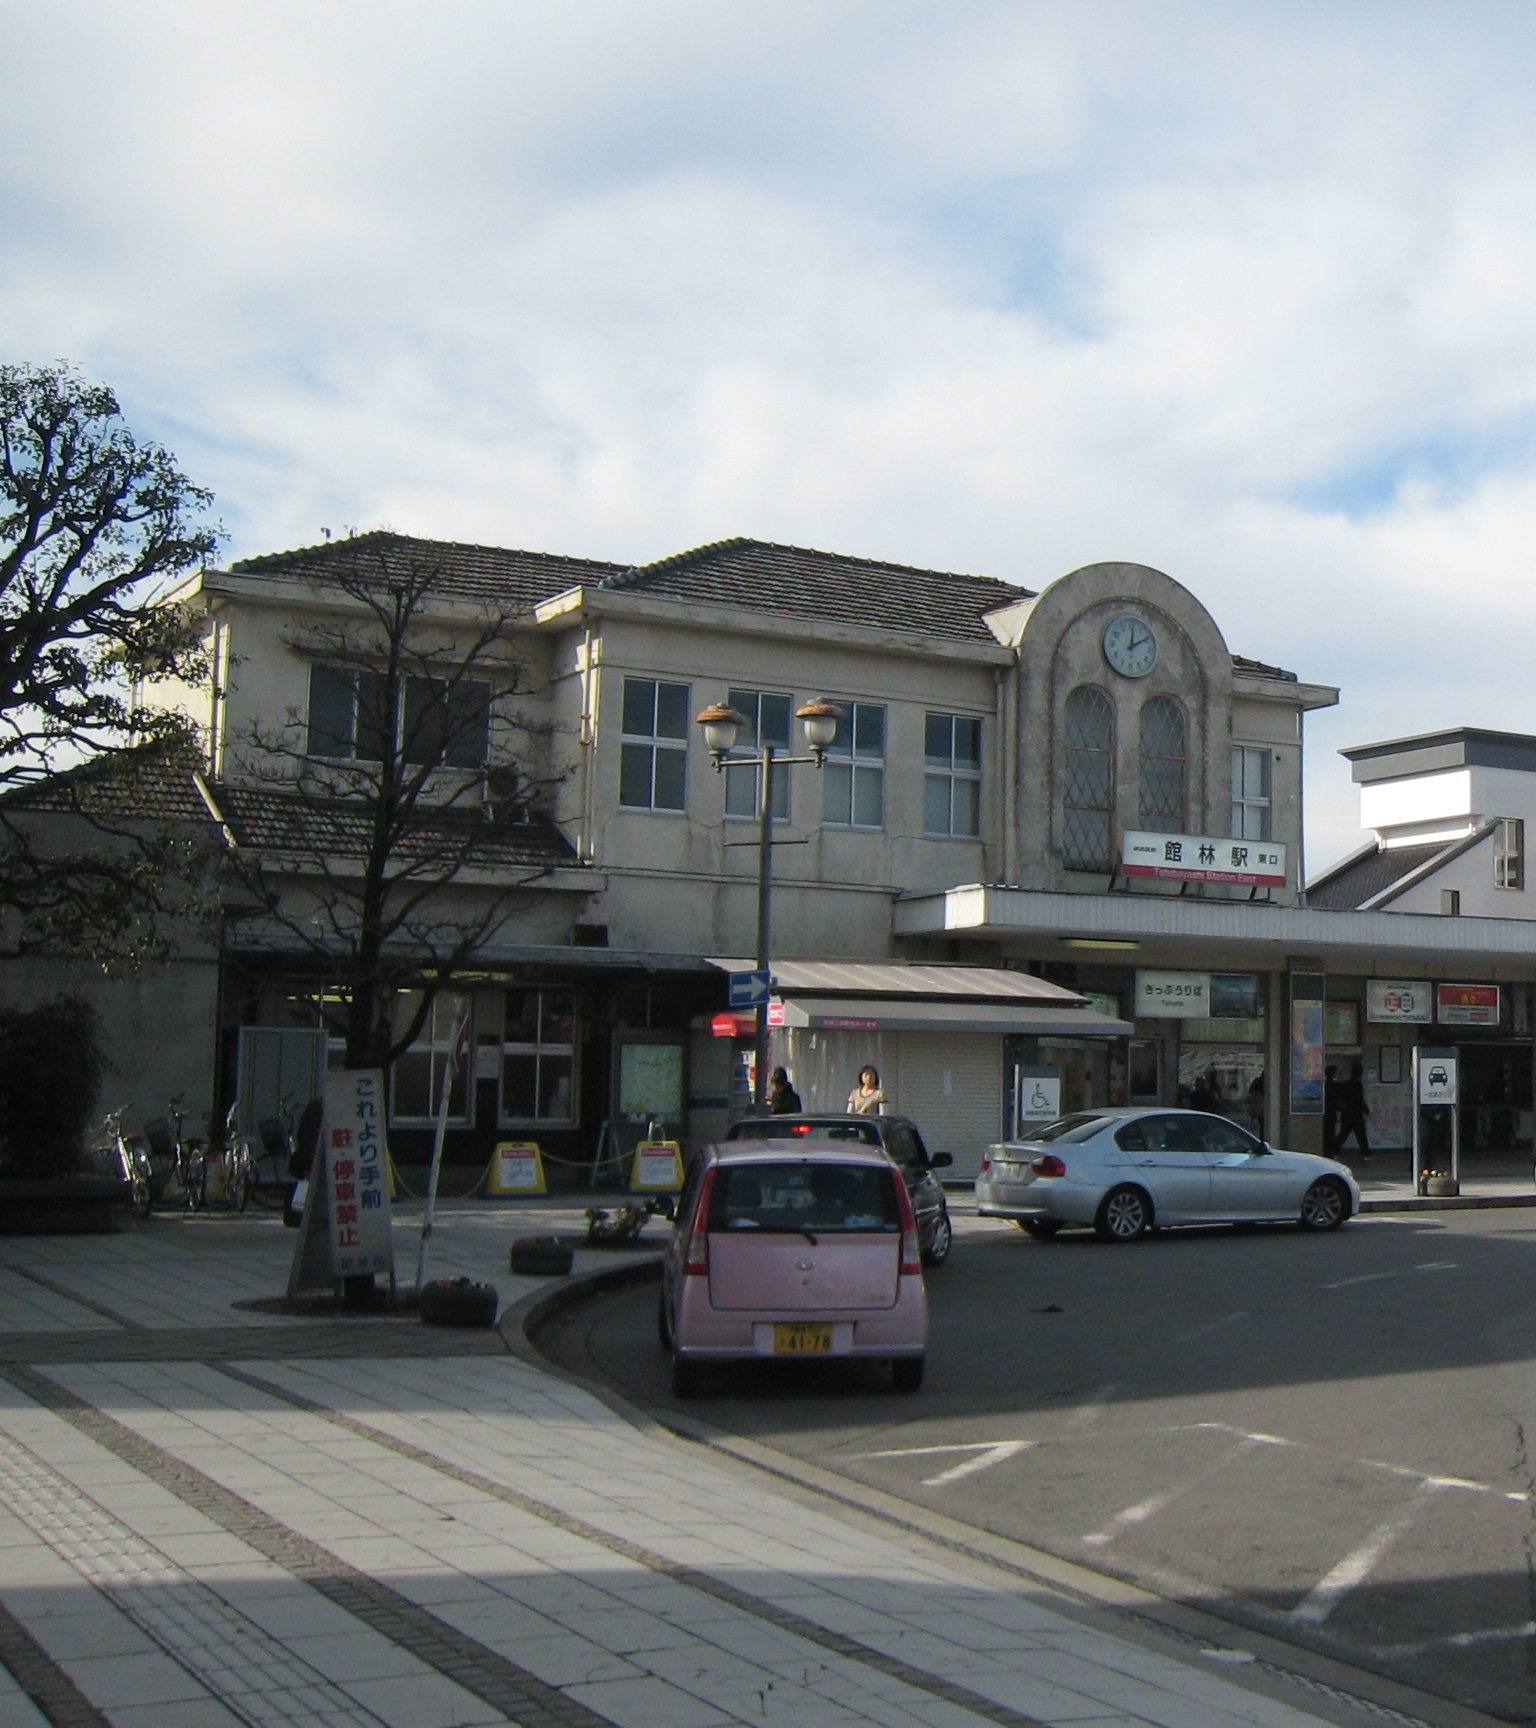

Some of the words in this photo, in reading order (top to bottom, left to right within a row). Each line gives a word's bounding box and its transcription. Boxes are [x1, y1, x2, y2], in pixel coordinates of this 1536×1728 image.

[1164, 840, 1249, 868] 館林駅
[1258, 853, 1278, 865] 東口
[1154, 867, 1205, 880] Tatebayashi
[1206, 870, 1236, 882] Station
[1237, 873, 1256, 883] East
[1144, 984, 1203, 997] きっぷうりば
[355, 1078, 382, 1210] これより手前
